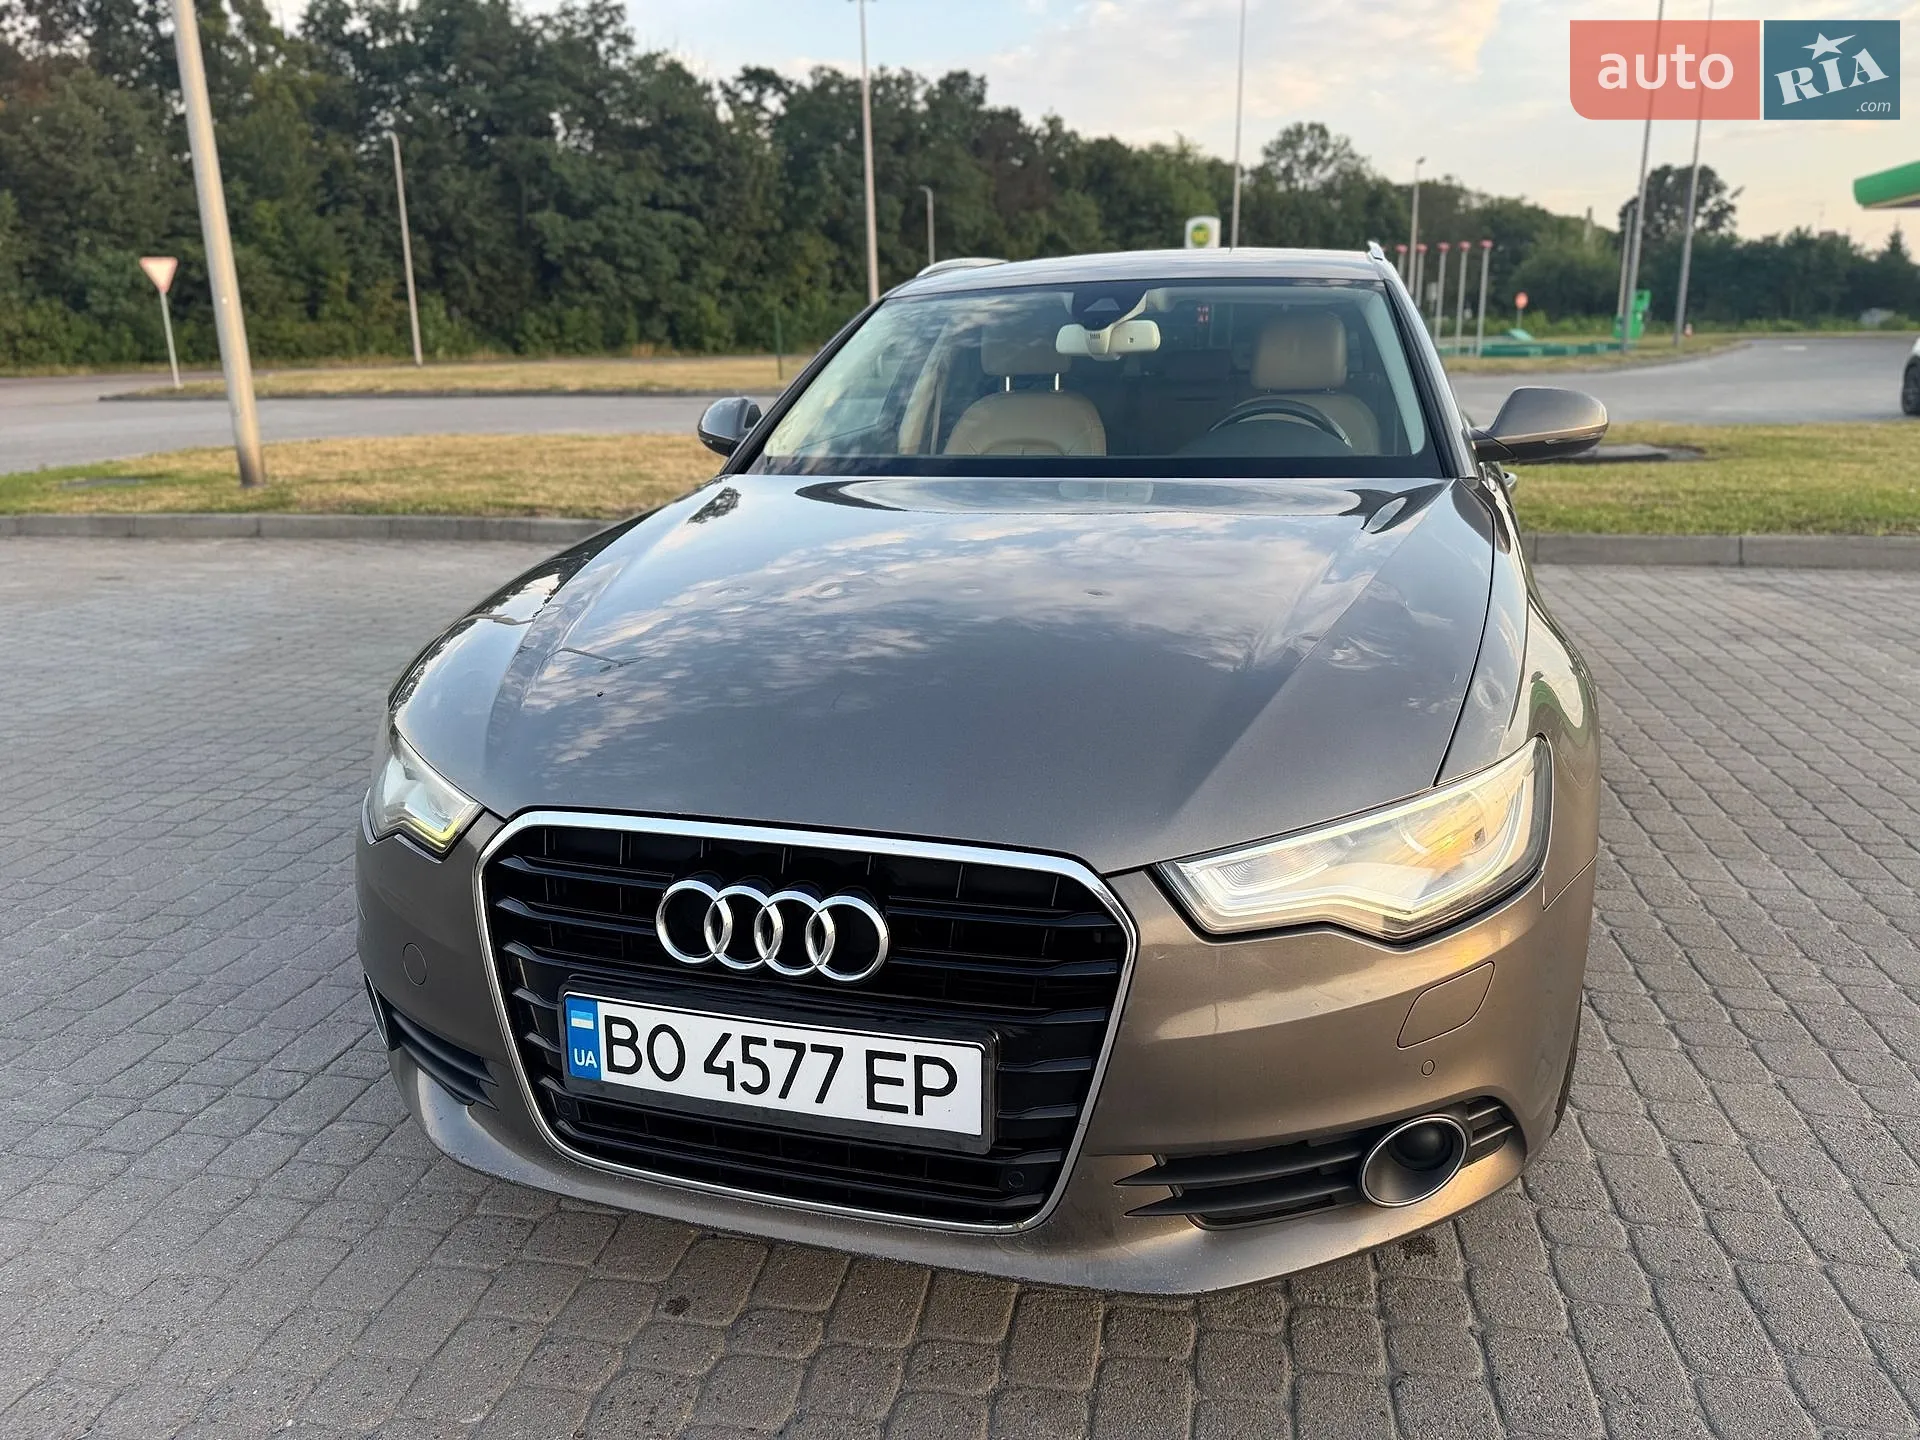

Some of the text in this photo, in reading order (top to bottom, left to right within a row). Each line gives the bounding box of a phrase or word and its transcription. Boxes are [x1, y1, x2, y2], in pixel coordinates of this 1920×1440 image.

[574, 1048, 598, 1069] UA
[604, 1014, 958, 1116] BO 4577 EP
